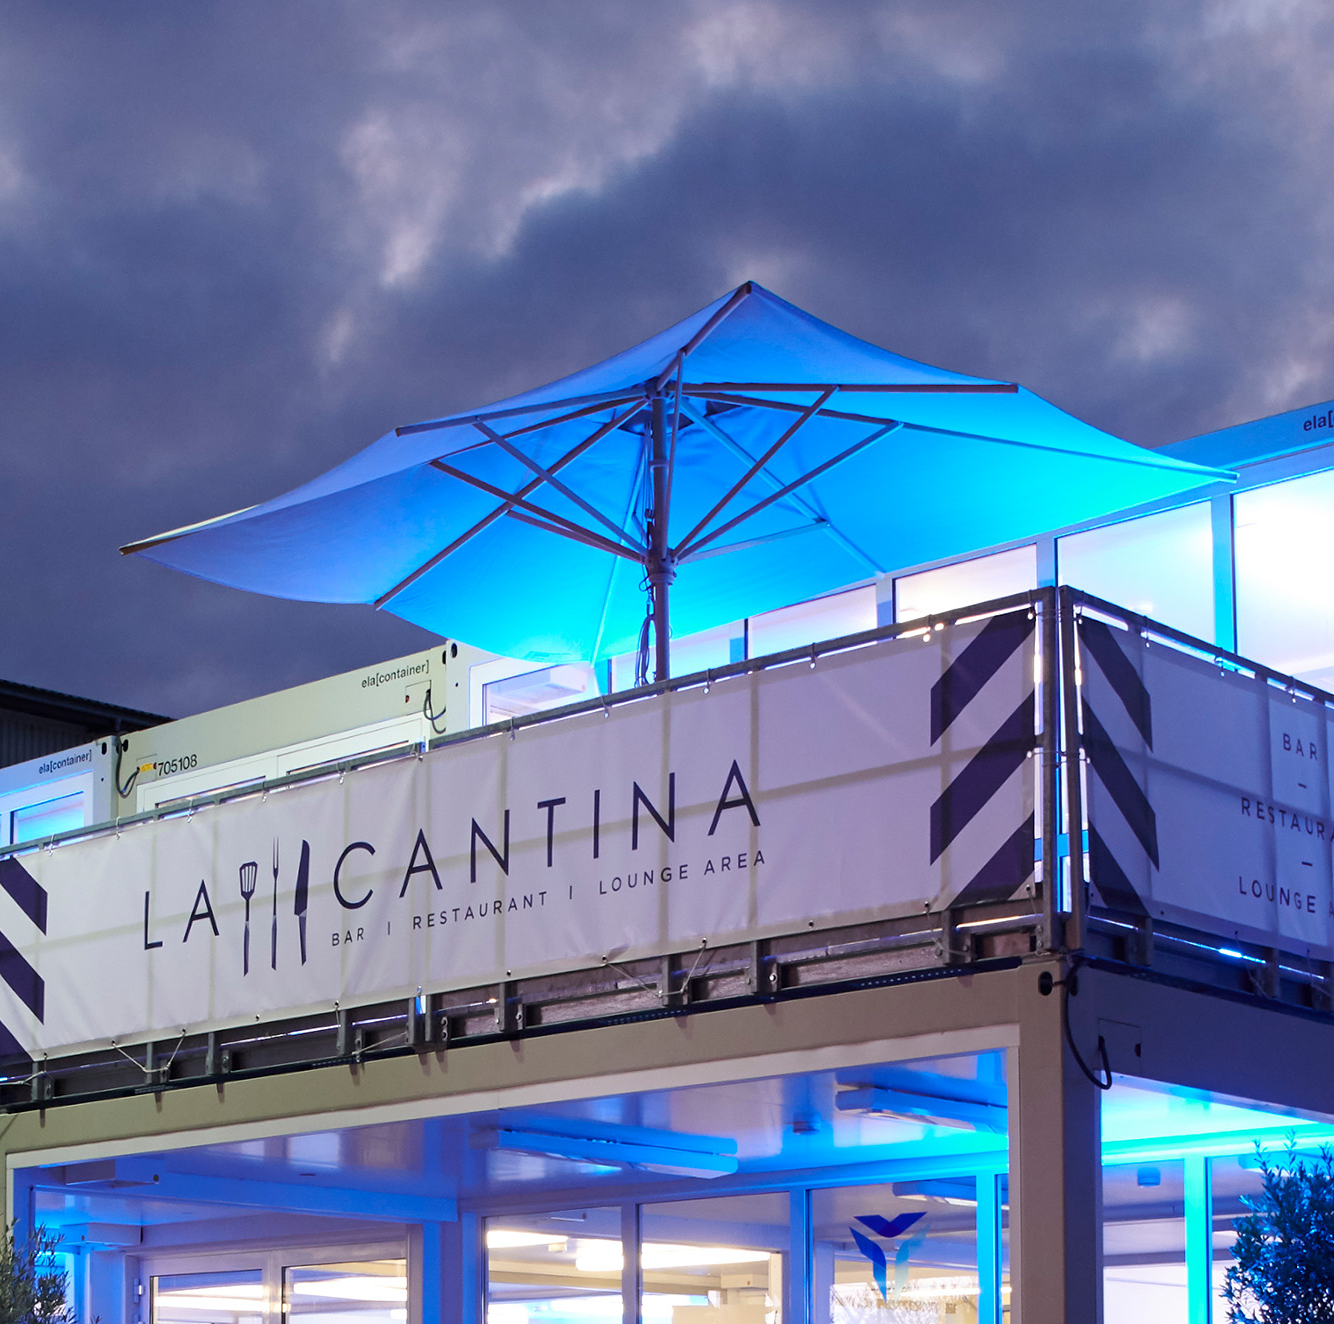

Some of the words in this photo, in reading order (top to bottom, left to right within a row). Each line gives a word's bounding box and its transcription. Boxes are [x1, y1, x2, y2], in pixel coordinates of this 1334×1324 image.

[361, 662, 430, 689] ela[container]
[1282, 732, 1320, 761] BAR
[39, 749, 92, 775] ela[container]
[157, 754, 198, 776] 705108
[143, 879, 220, 951] LA
[332, 758, 761, 911] CANTINA
[331, 925, 366, 948] BAR
[411, 890, 548, 931] RESTAURANT
[598, 862, 689, 896] LOUNGE
[703, 849, 767, 877] AREA
[1237, 876, 1317, 914] LOUNGE
